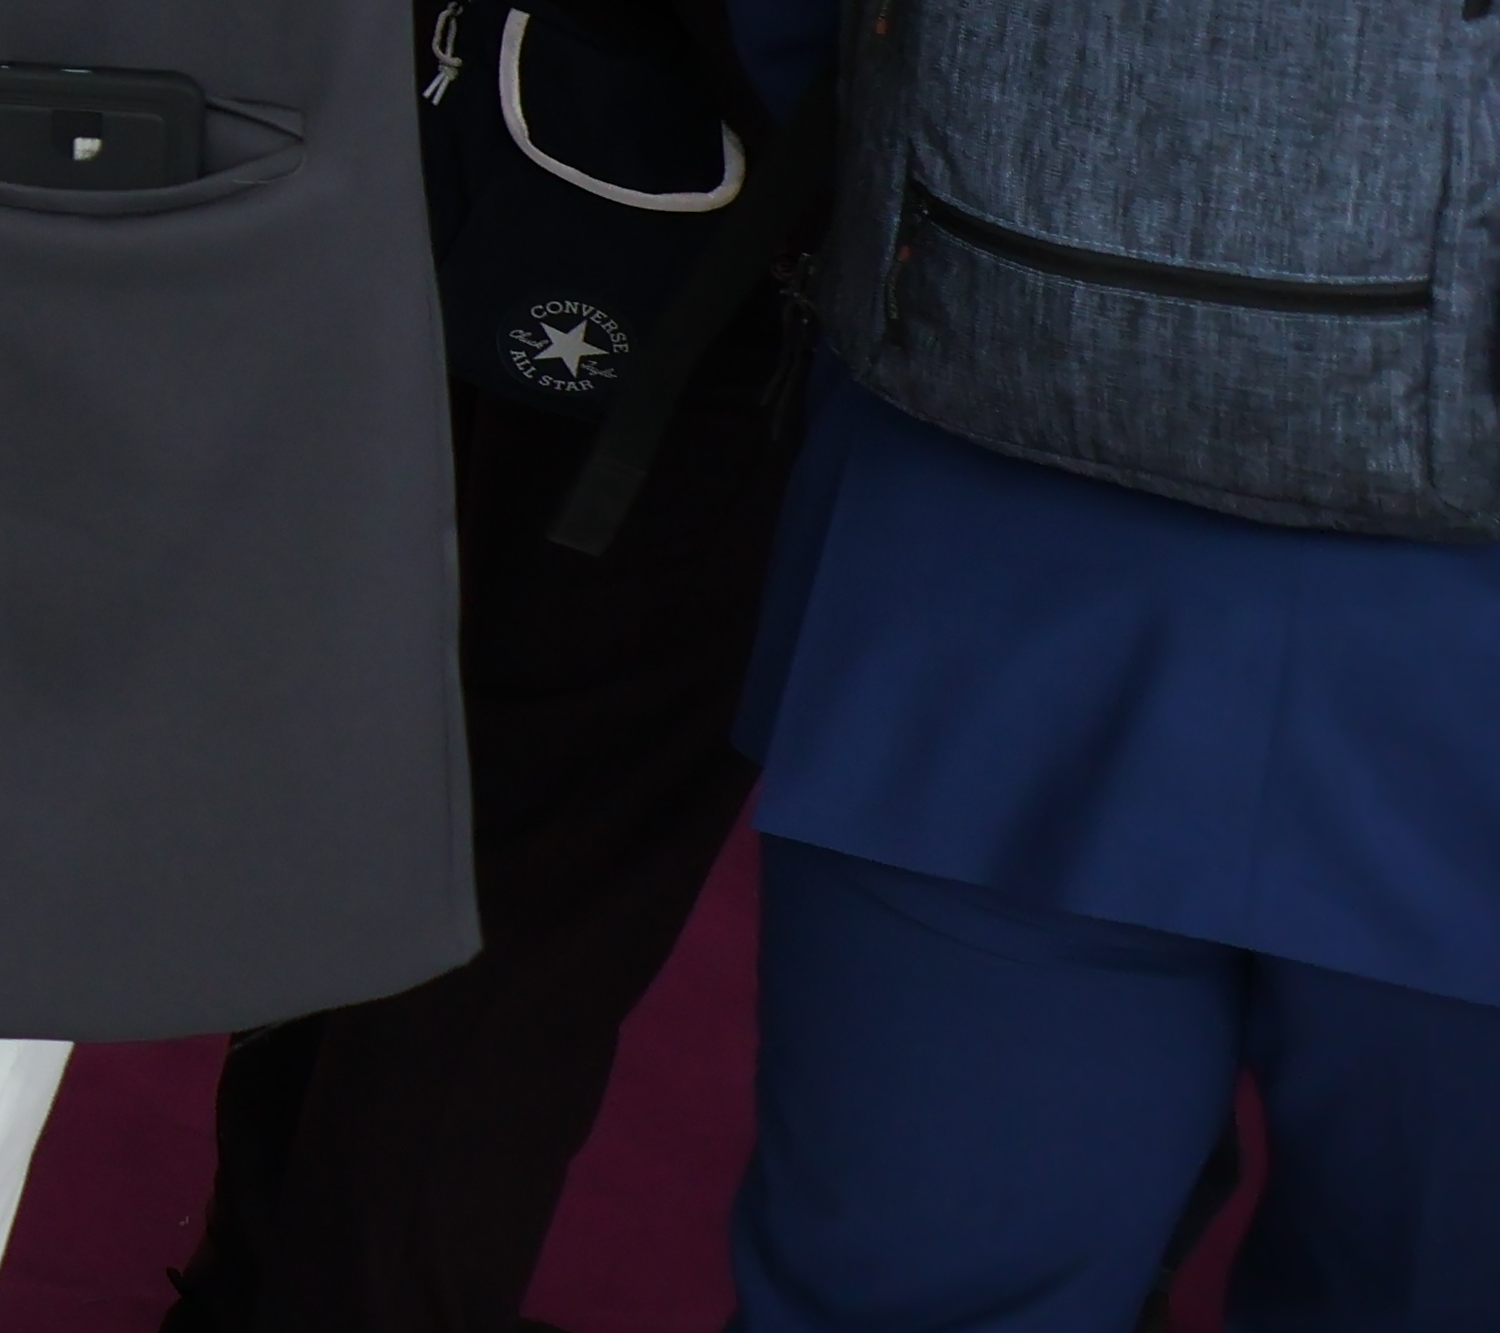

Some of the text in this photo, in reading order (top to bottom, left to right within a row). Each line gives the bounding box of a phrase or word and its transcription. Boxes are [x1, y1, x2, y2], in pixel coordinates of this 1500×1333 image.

[529, 300, 629, 353] CONVERSE
[509, 349, 595, 392] ALL STAR
